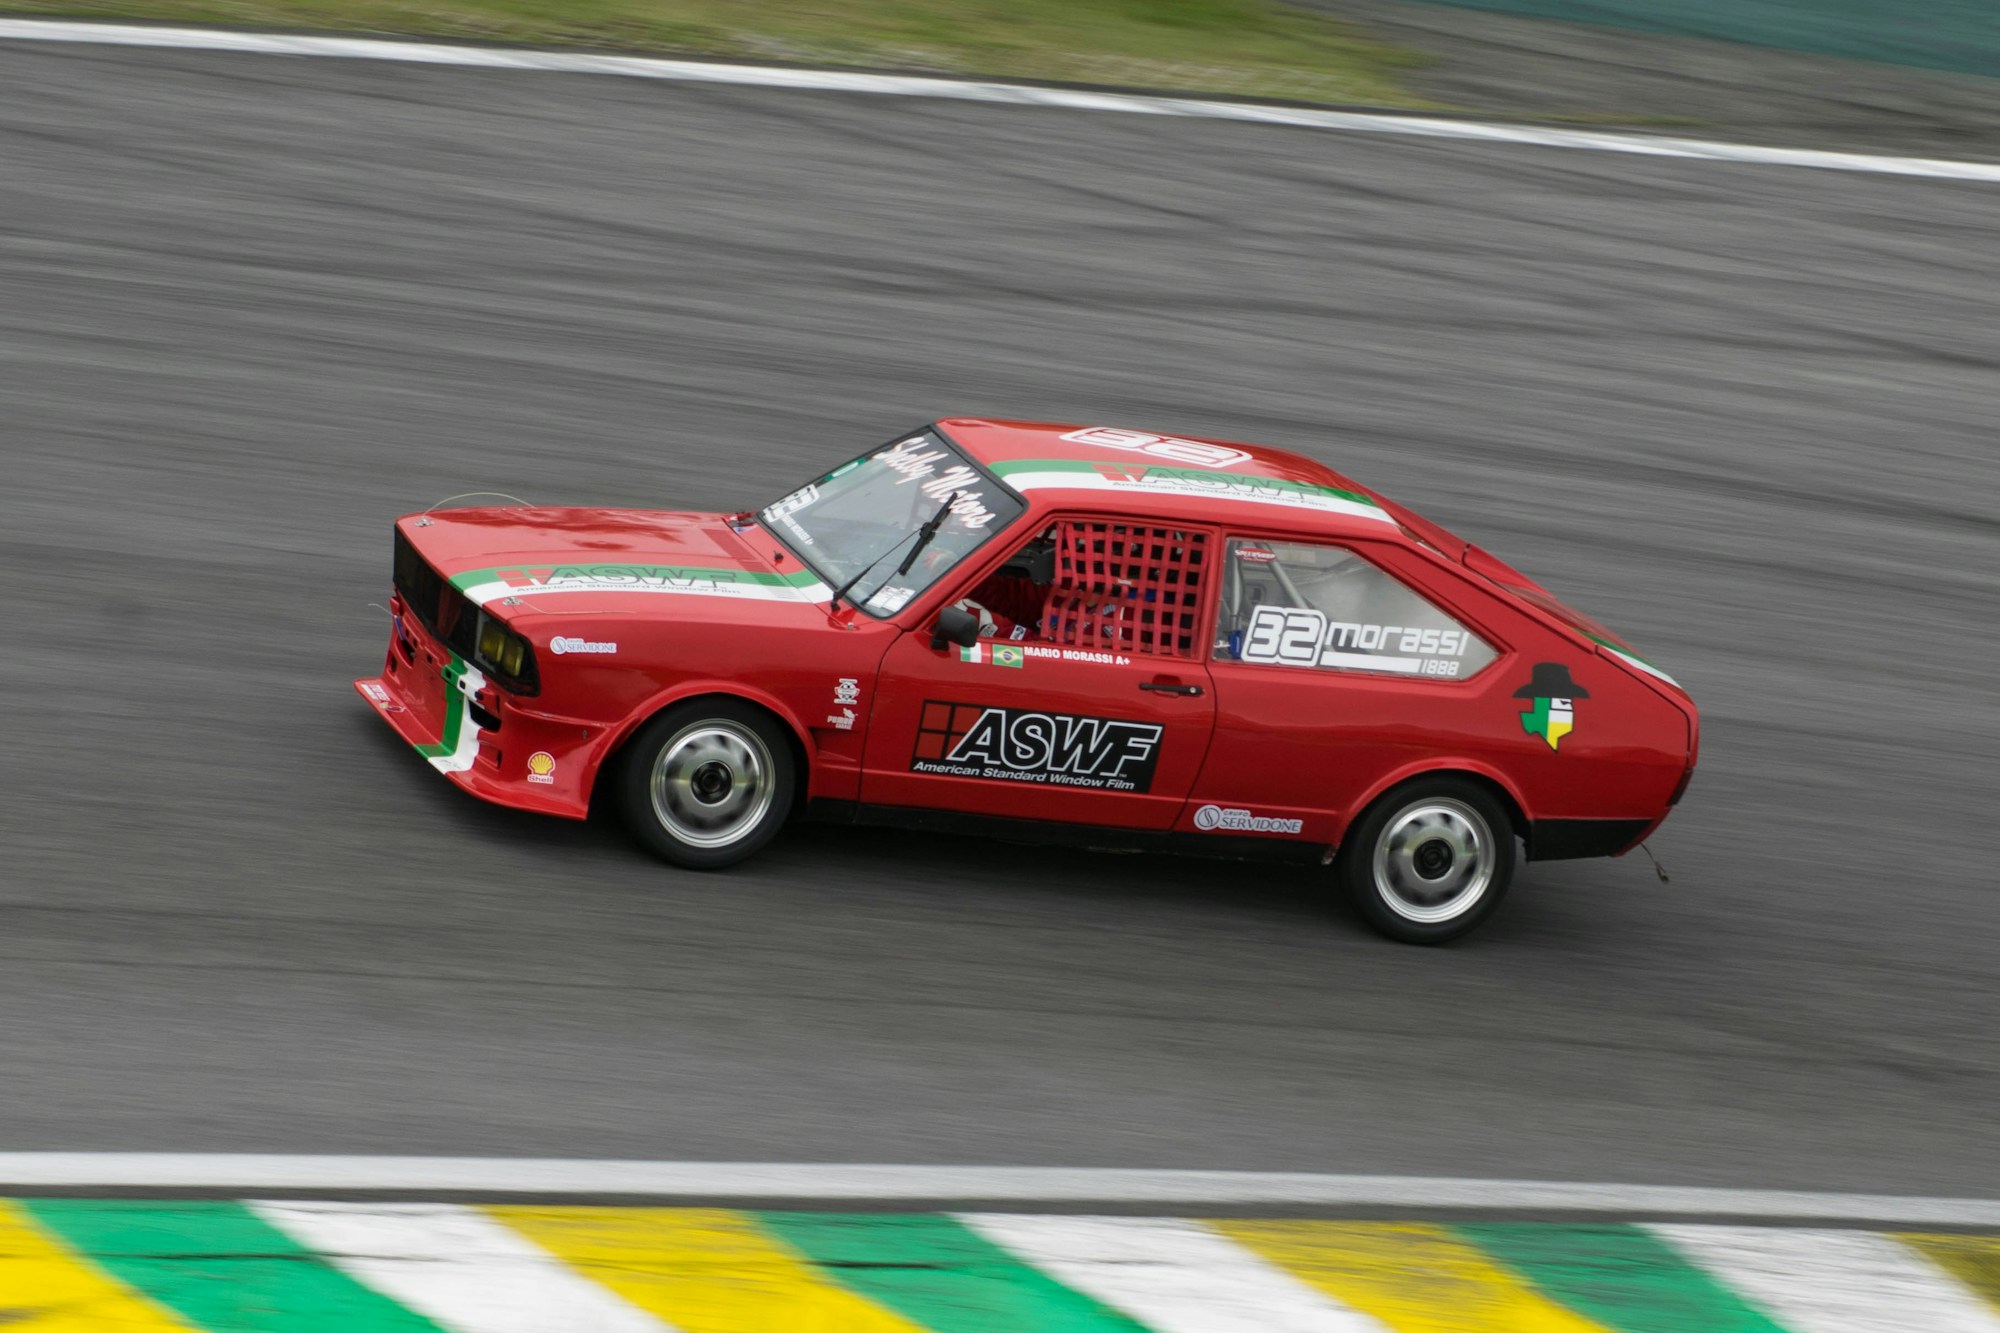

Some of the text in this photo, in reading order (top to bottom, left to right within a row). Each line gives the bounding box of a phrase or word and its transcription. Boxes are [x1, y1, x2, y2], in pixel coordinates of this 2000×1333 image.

[873, 437, 948, 485] Shelby
[1112, 481, 1328, 507] American Standard Window Film
[1139, 467, 1321, 500] ASWF
[516, 584, 583, 592] American
[655, 584, 710, 592] Window
[545, 566, 737, 589] ASWF
[567, 643, 615, 652] SERVIDONE
[1246, 609, 1325, 663] 32
[1023, 646, 1131, 666] MARIO MORASSI A+
[1421, 659, 1460, 676] 1888
[946, 708, 1164, 777] ASWF
[529, 775, 553, 783] Shell
[913, 761, 1135, 790] American Standard Window Film
[1219, 816, 1301, 832] SERVIDONE
